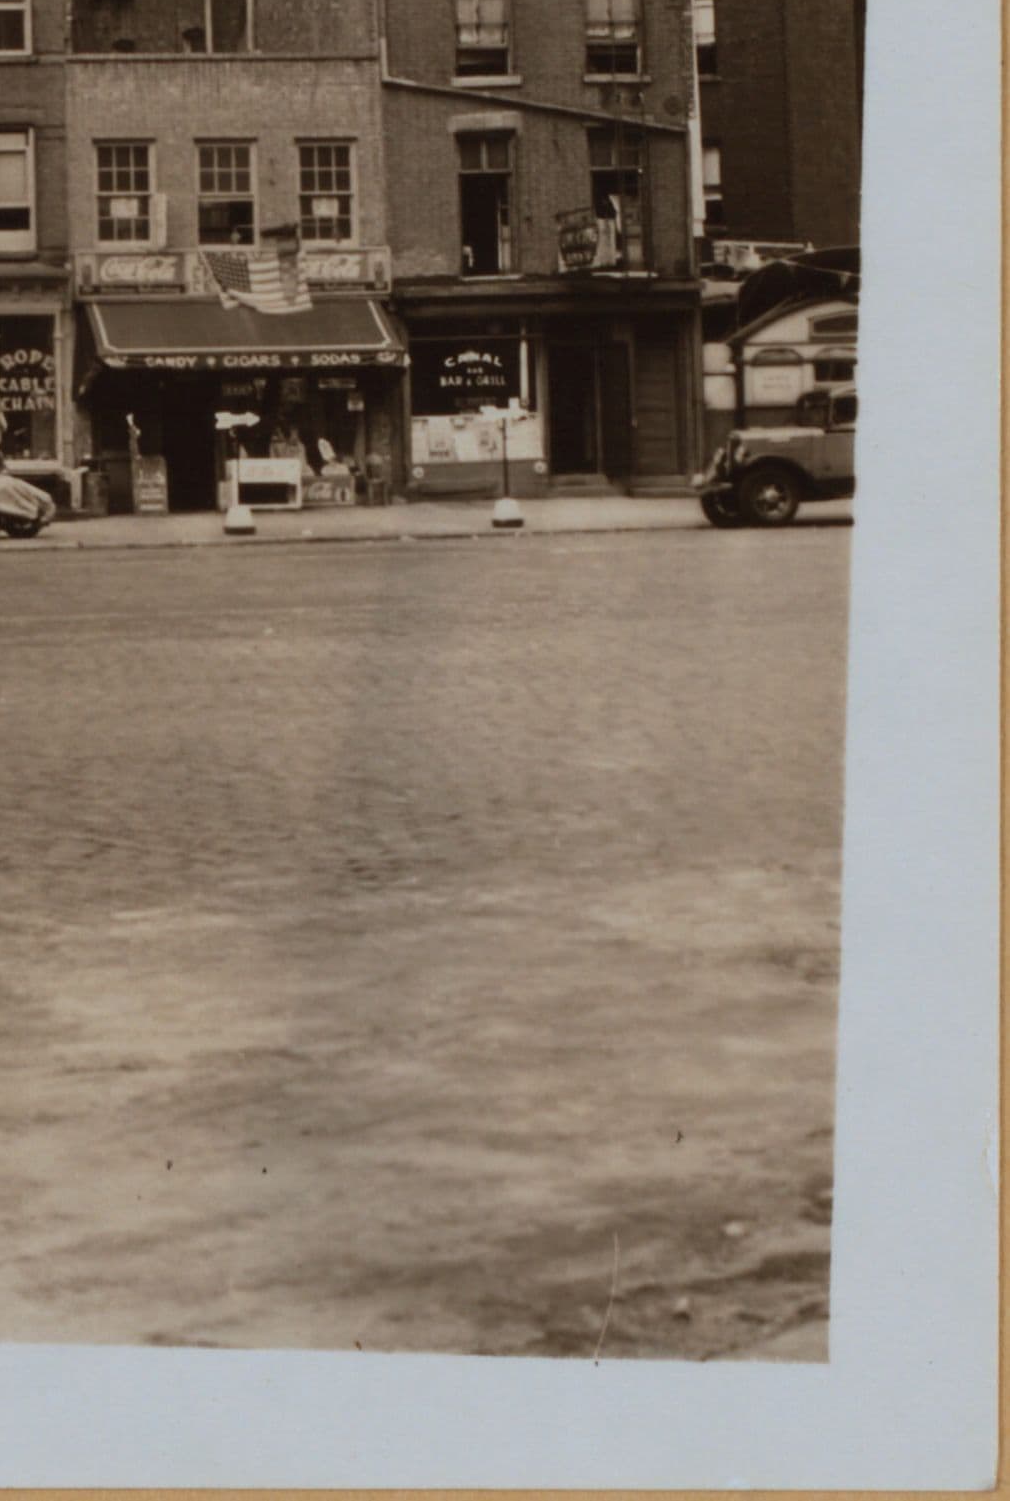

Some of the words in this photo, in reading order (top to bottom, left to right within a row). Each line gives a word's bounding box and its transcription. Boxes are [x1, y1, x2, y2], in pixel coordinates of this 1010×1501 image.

[144, 355, 197, 368] CANDY
[222, 354, 280, 367] CIGARS
[311, 353, 361, 366] SODAS
[444, 351, 503, 367] CANAL
[440, 375, 463, 387] BAR
[476, 375, 506, 386] GRILL
[0, 396, 55, 411] CHAIN
